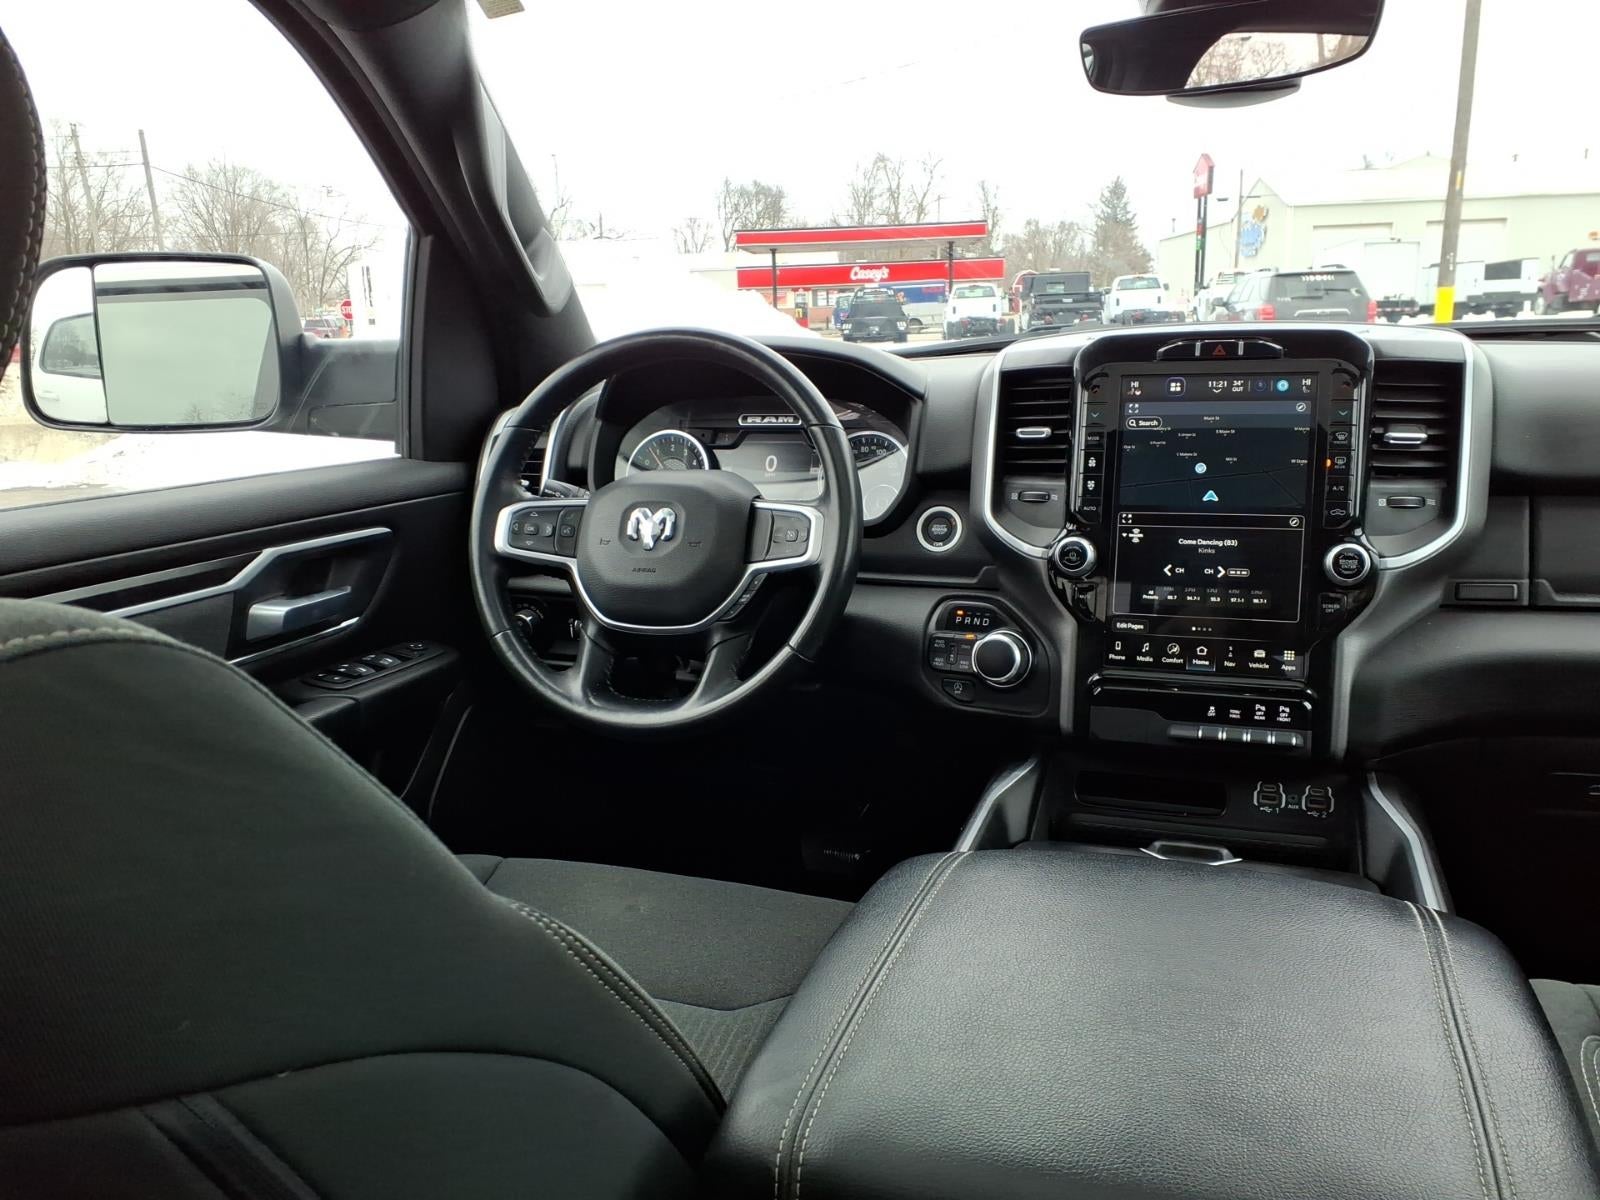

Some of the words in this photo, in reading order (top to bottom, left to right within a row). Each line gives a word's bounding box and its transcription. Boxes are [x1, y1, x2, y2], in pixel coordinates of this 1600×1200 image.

[850, 266, 890, 282] Casey's
[1208, 380, 1227, 388] 11:21
[765, 455, 777, 472] 0
[1197, 539, 1223, 547] Dancing
[983, 618, 990, 626] D
